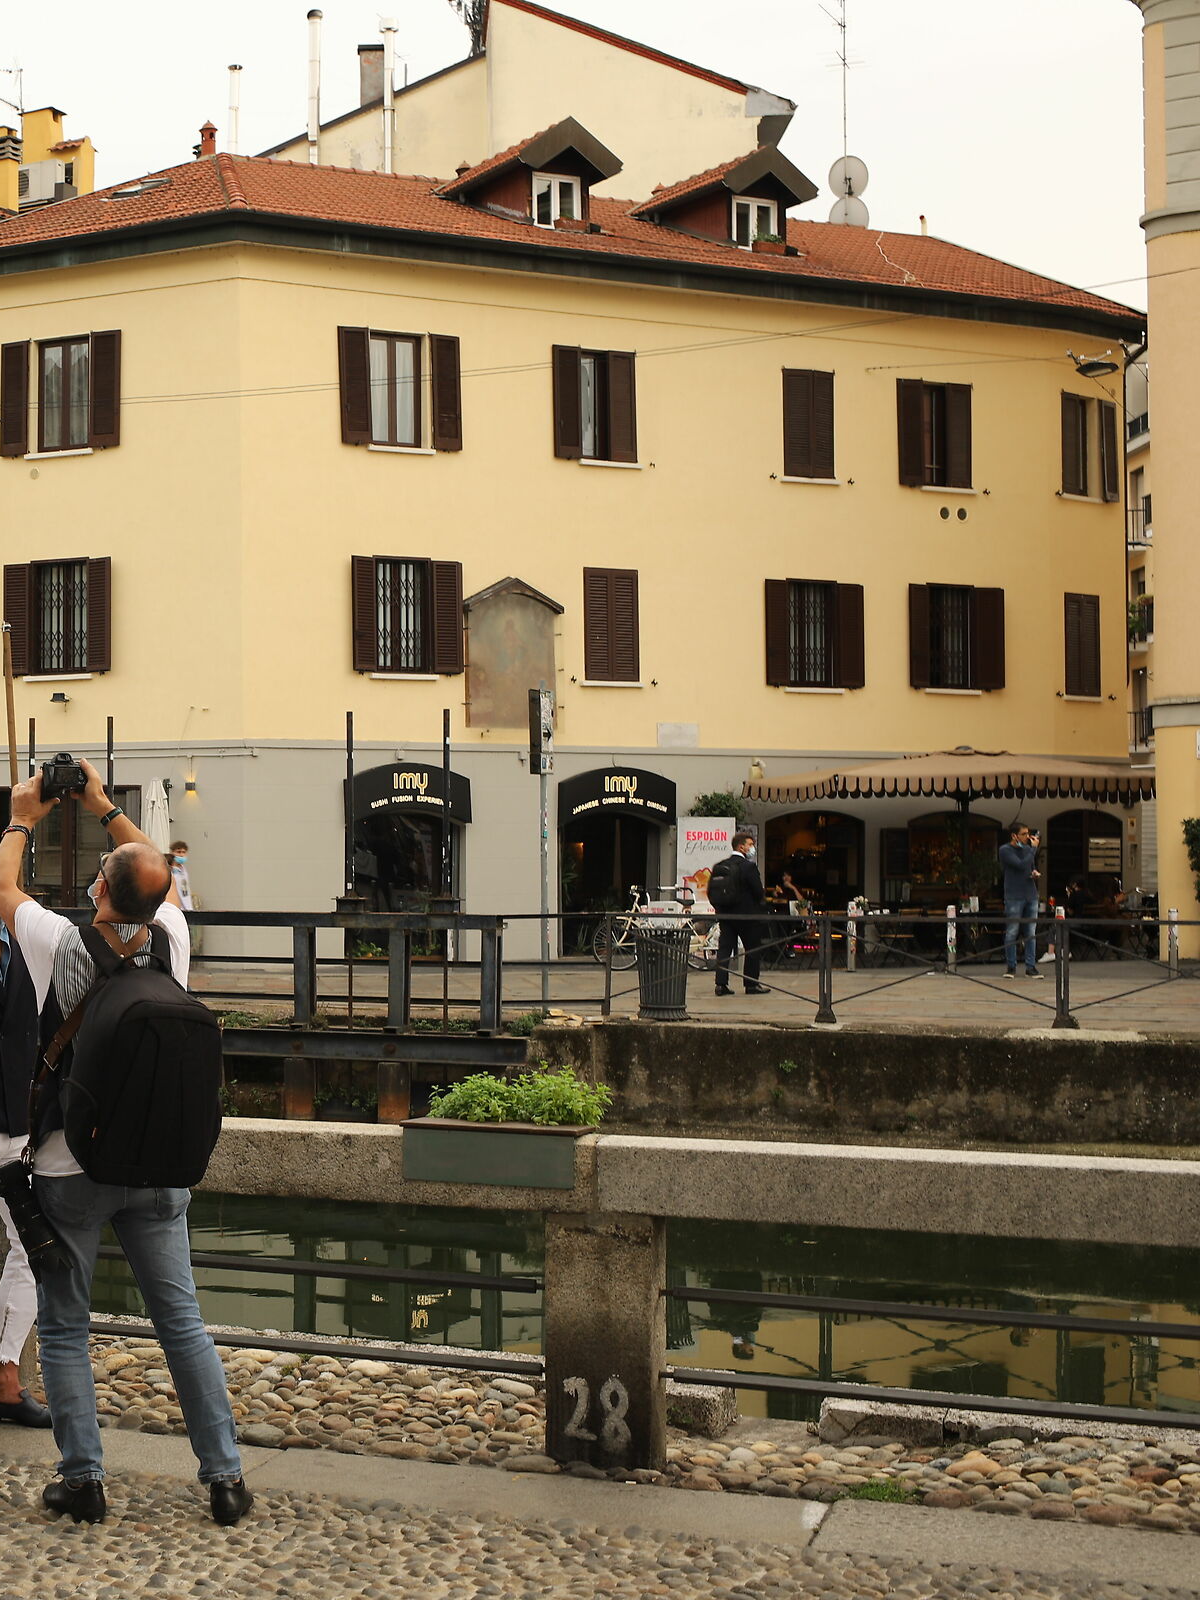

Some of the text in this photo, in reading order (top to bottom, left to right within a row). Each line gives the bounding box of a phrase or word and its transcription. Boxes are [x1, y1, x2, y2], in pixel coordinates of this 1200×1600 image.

[371, 798, 389, 809] SUSHI
[392, 795, 413, 804] FUSION
[572, 799, 600, 815] JAPANESE
[602, 796, 626, 805] CHINESE
[628, 797, 644, 806] POKE
[562, 1375, 631, 1453] 28
